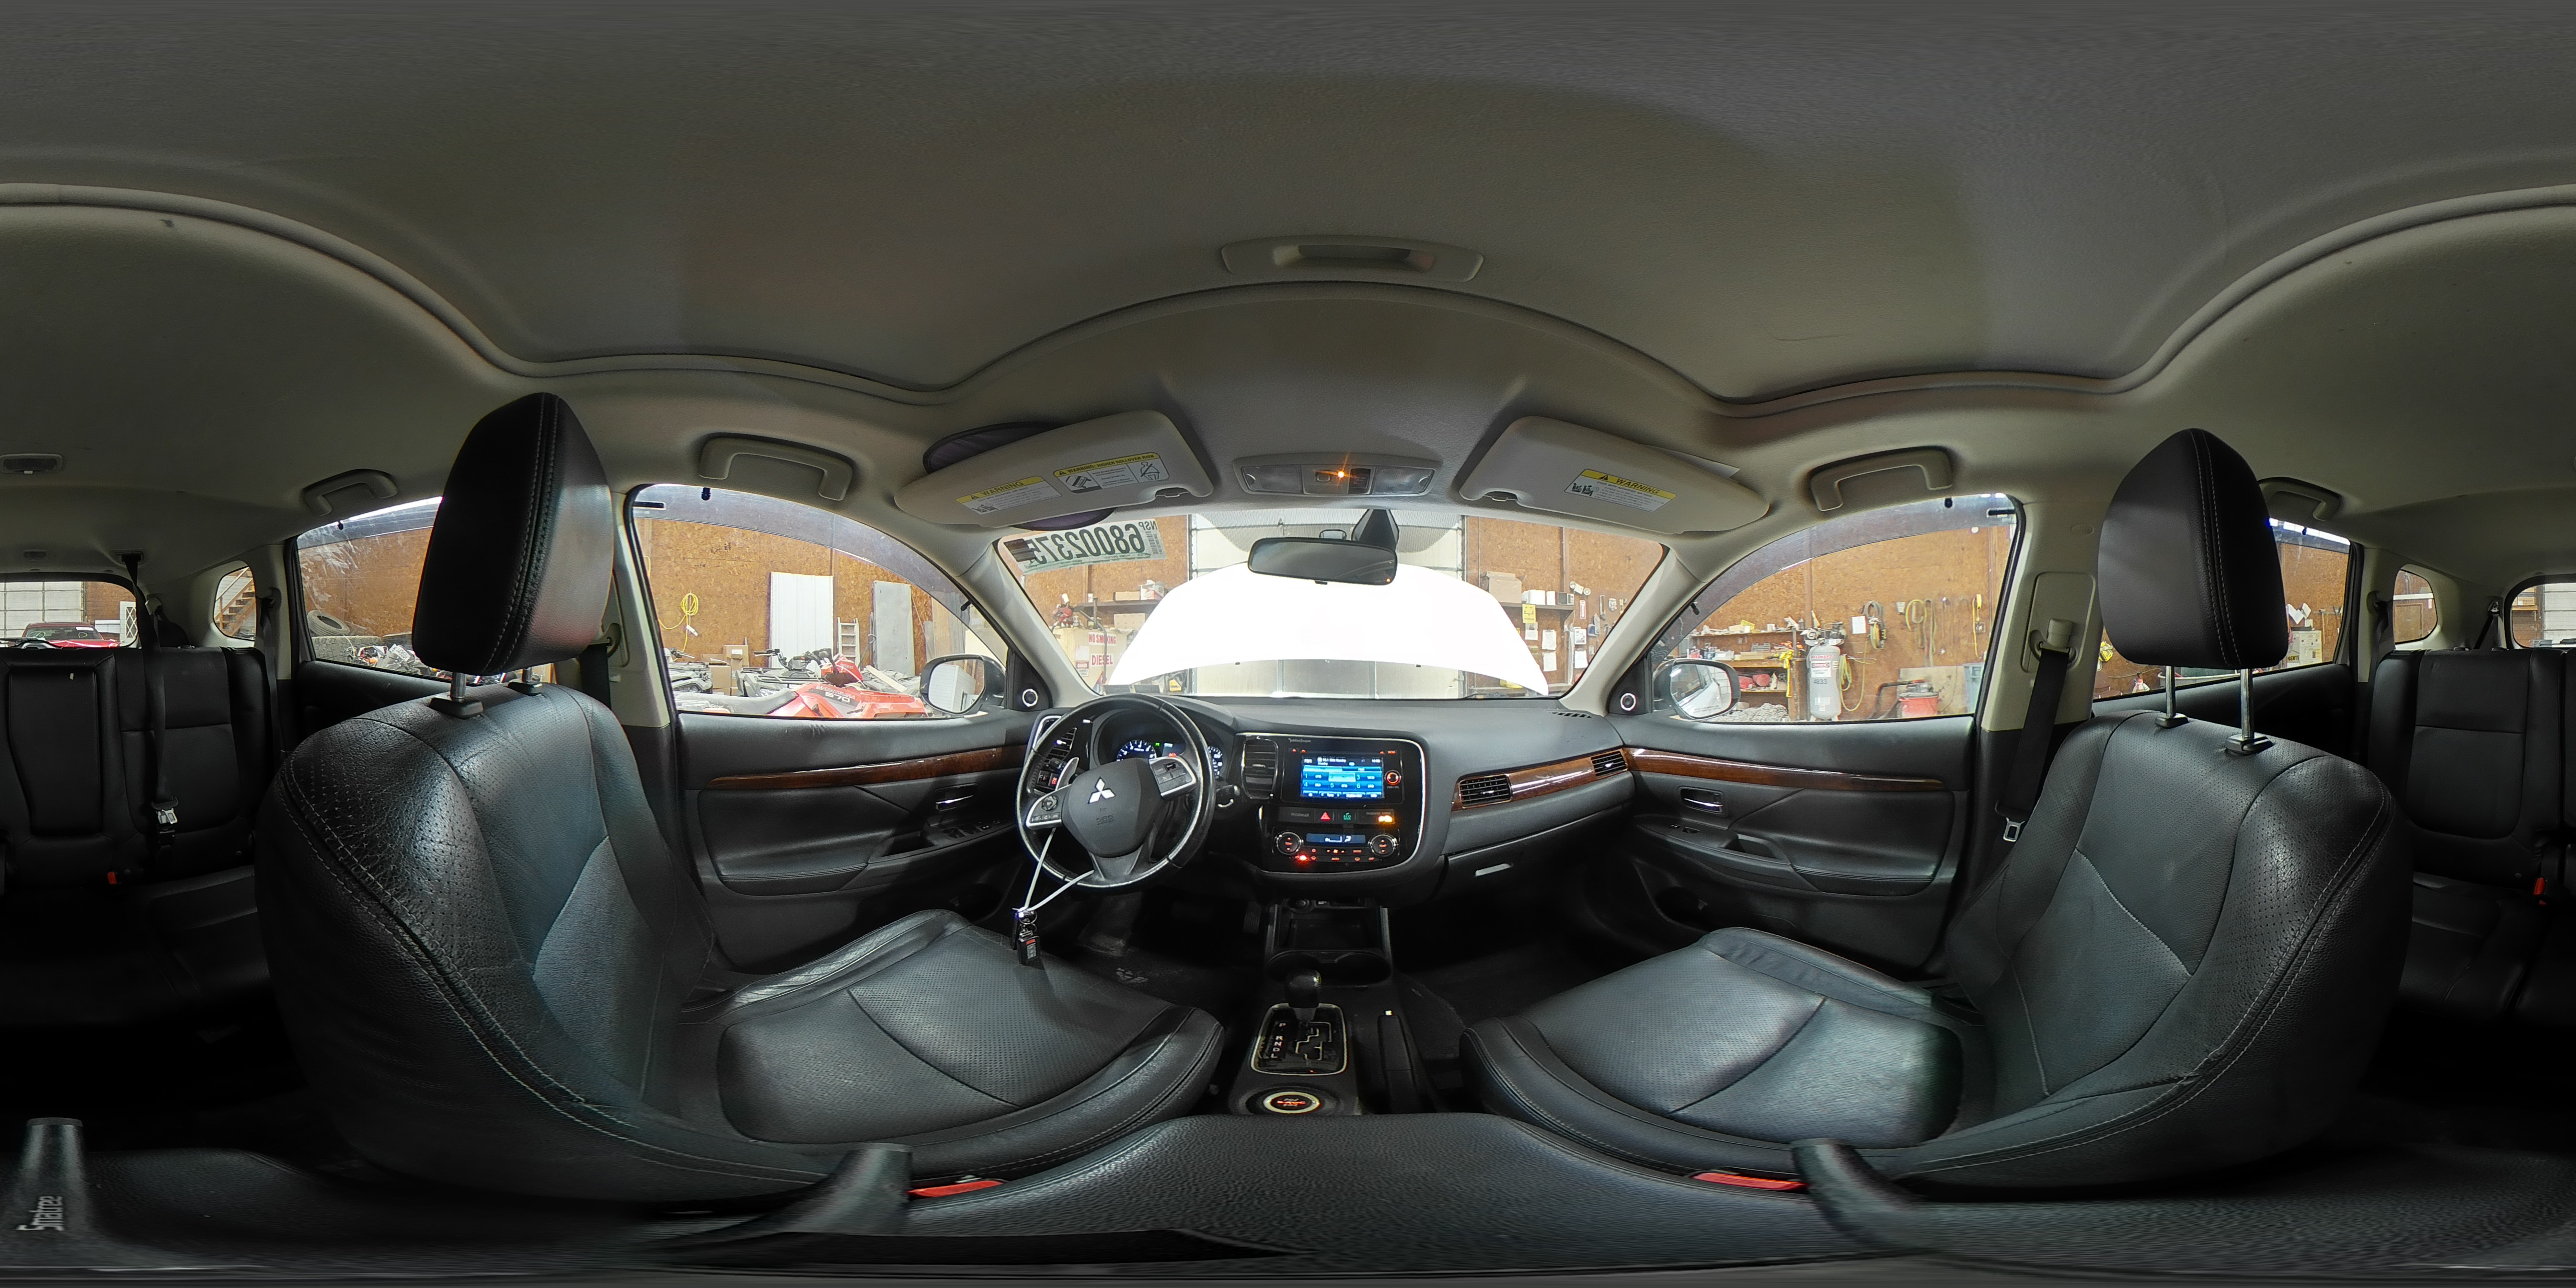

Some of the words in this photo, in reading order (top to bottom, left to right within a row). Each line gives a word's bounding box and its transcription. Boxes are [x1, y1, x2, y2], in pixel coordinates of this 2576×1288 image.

[1067, 464, 1096, 473] WARNING:
[980, 481, 1024, 496] WARNING
[1616, 478, 1661, 494] WARNING
[1089, 633, 1095, 643] NO
[1092, 655, 1113, 666] DIESEL
[825, 691, 851, 703] 570
[16, 1196, 65, 1231] Smatree
